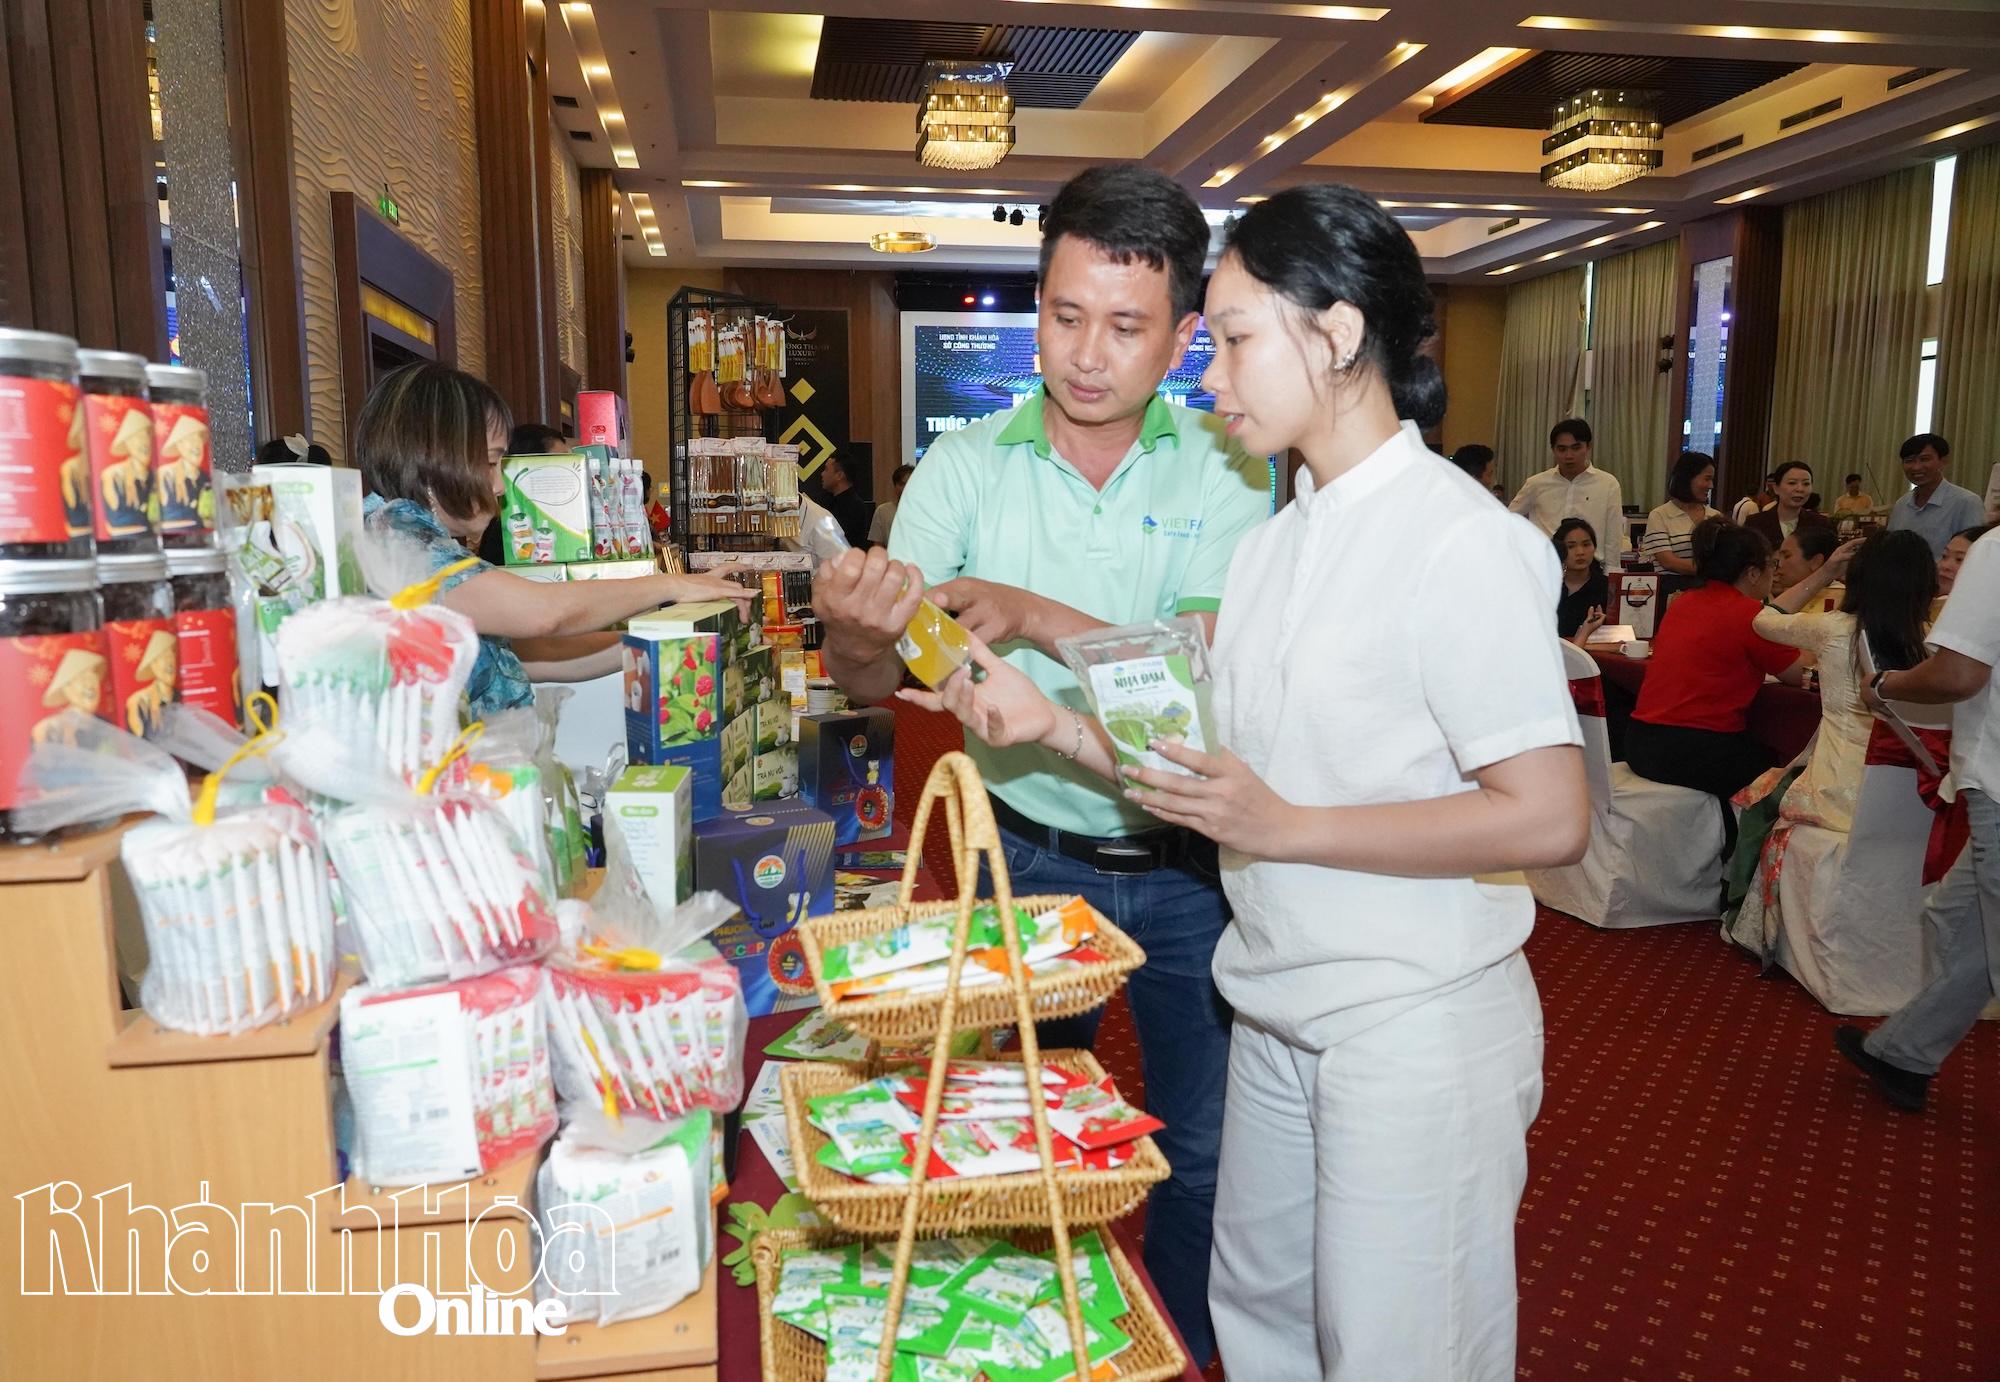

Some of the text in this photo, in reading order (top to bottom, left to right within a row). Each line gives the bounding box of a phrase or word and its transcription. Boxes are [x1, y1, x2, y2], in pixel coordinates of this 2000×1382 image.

[939, 333, 955, 341] UBND
[955, 332, 968, 341] TỈNH
[968, 332, 988, 341] KHÁNH
[942, 341, 996, 350] SỞ CÔNG THƯƠNG
[925, 414, 967, 432] THÚC
